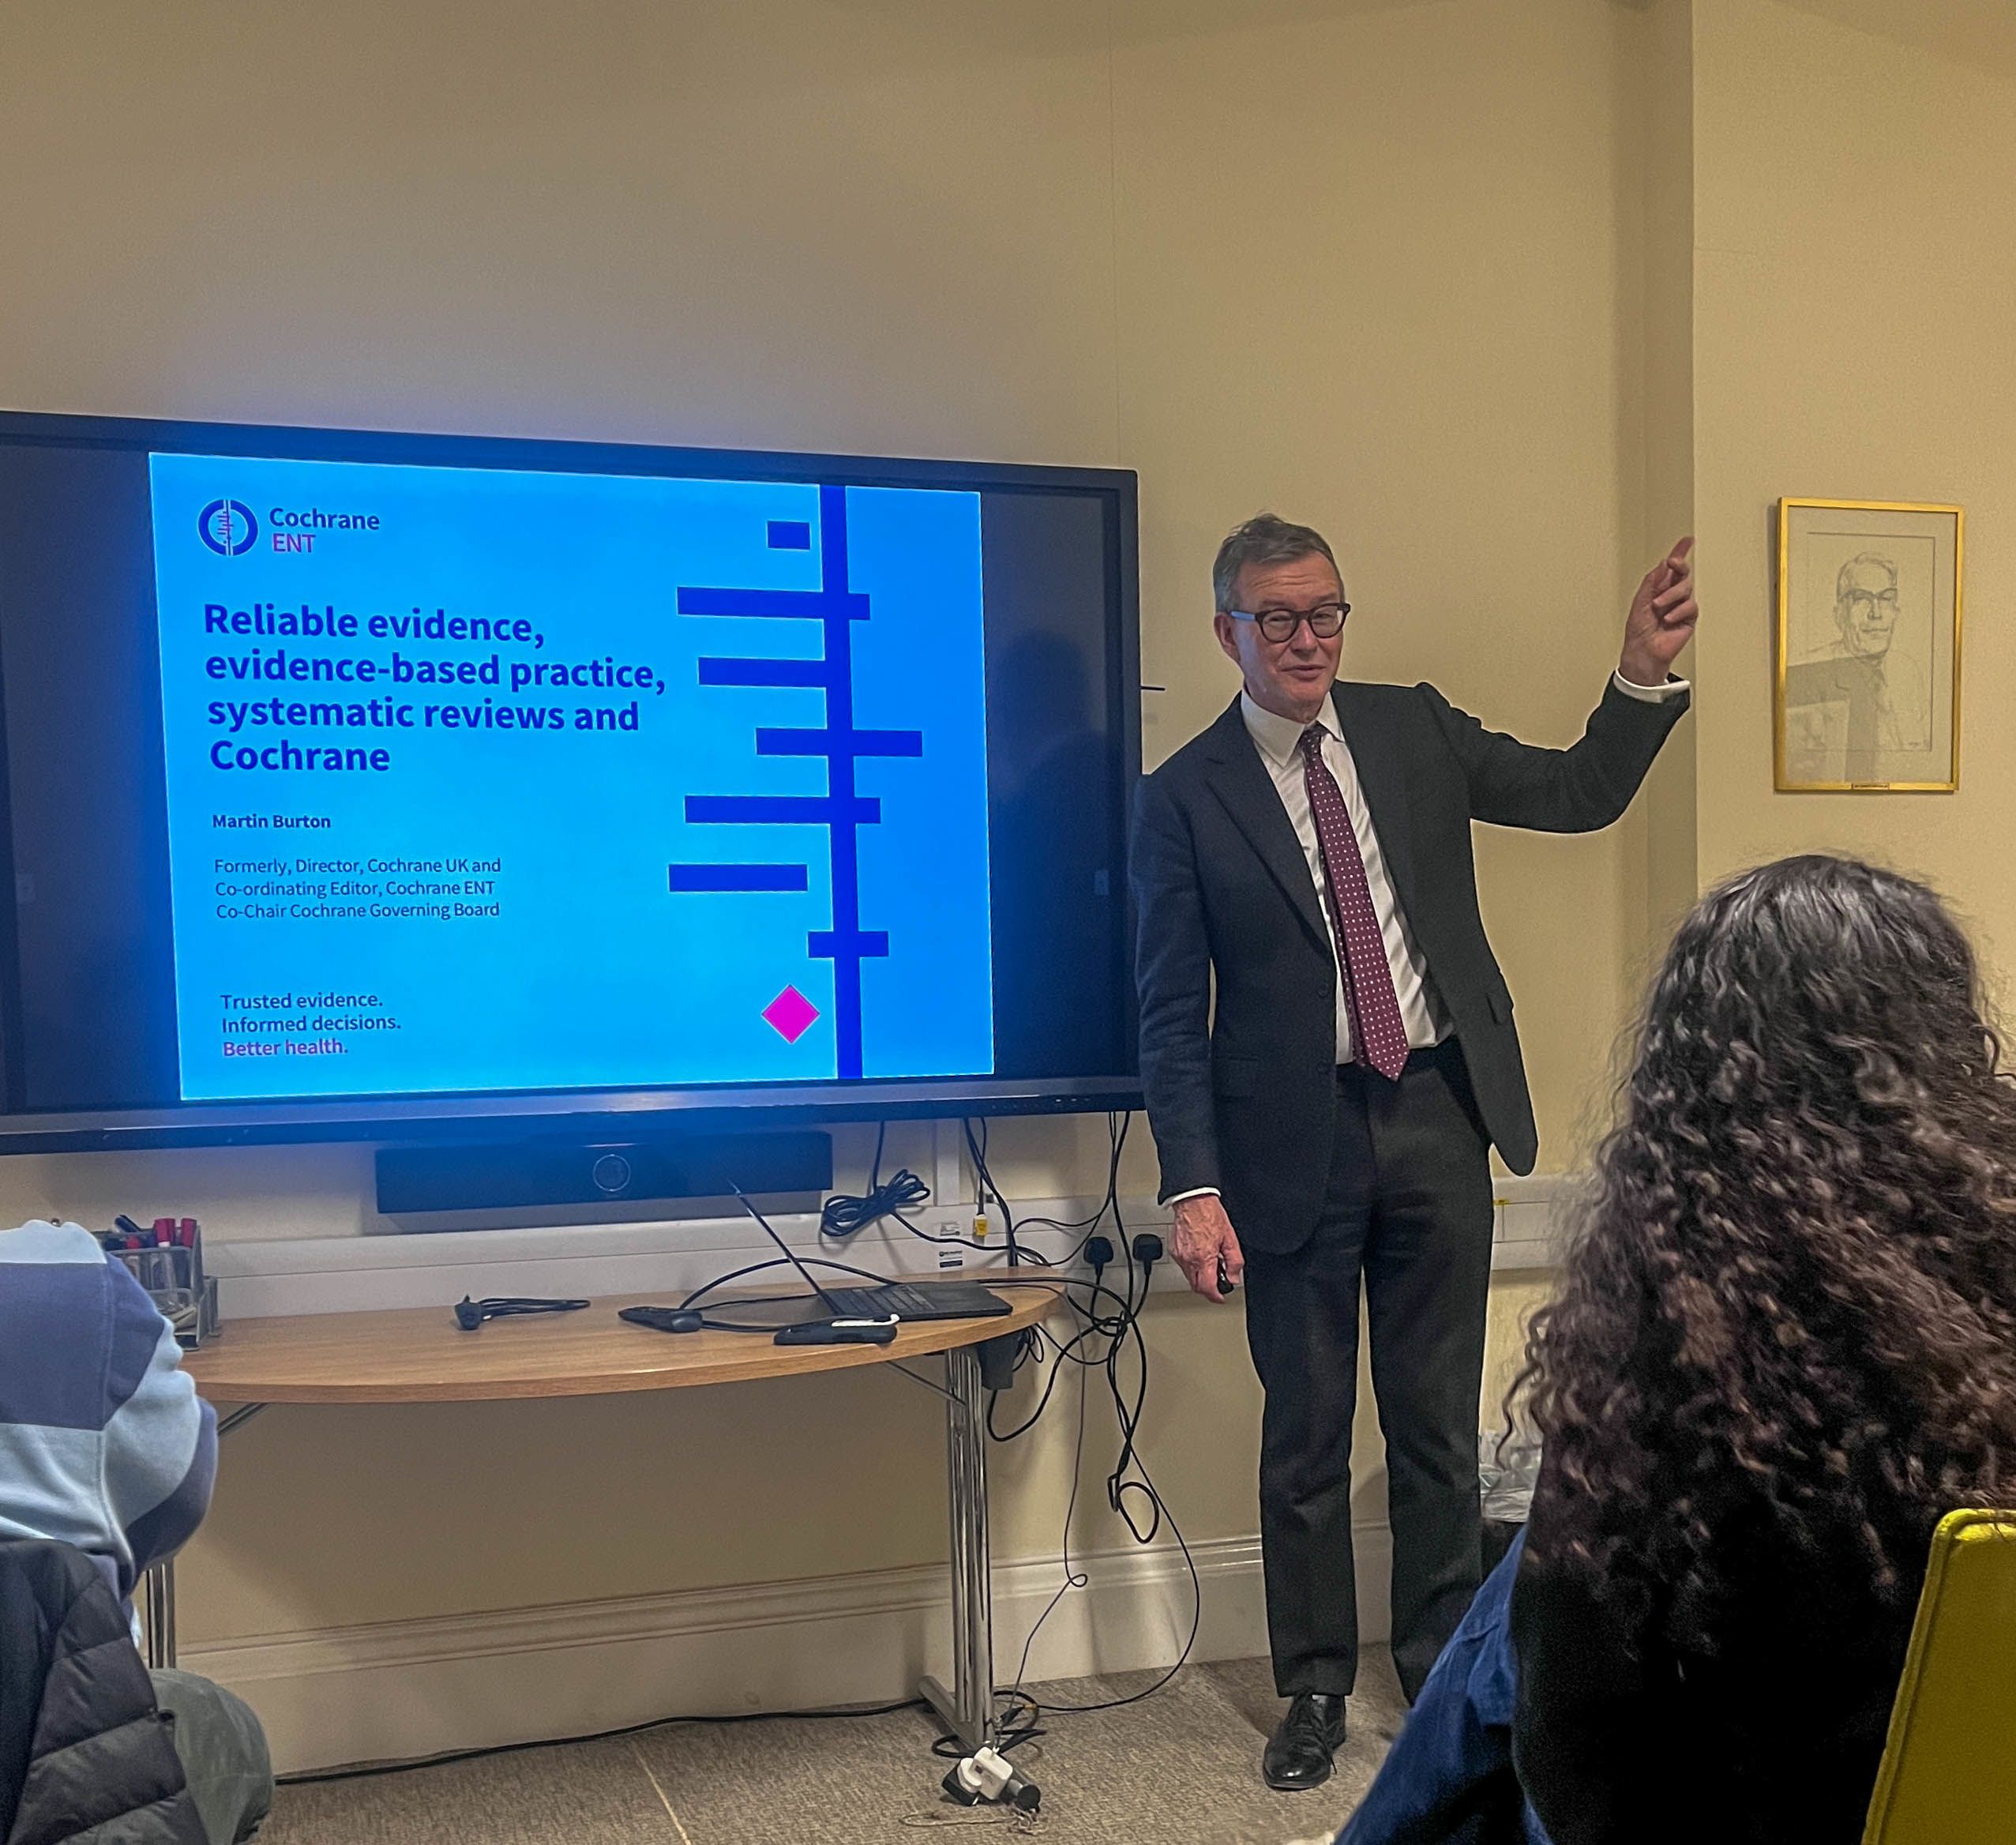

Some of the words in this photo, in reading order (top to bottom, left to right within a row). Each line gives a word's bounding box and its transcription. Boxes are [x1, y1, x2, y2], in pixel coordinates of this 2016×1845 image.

[270, 507, 380, 531] Cochrane
[272, 532, 316, 553] ENT
[205, 603, 358, 637] Reliable
[368, 607, 544, 649] evidence,
[206, 648, 500, 686] evidence-based
[511, 656, 666, 695] practice,
[208, 696, 415, 733] systematic
[424, 697, 565, 730] reviews
[574, 701, 639, 731] and
[210, 739, 390, 772] Cochrane
[212, 814, 268, 829] Martin
[272, 814, 332, 829] Burton
[215, 859, 292, 877] Formerly,
[296, 859, 364, 876] Director,
[367, 858, 443, 873] Cochrane
[446, 859, 469, 873] UK
[471, 858, 501, 873] and
[216, 881, 327, 899] Co-ordinating
[331, 881, 383, 897] Editor,
[386, 880, 461, 895] Cochrane
[464, 881, 495, 895] ENT
[216, 904, 287, 919] Co-Chair
[291, 904, 366, 918] Cochrane
[370, 903, 451, 920] Governing
[454, 902, 500, 917] Board
[220, 993, 292, 1009] Trusted
[296, 992, 383, 1009] evidence.
[222, 1016, 307, 1033] Informed
[311, 1014, 401, 1031] decisions.
[223, 1041, 281, 1057] Better
[285, 1038, 348, 1055] health.
